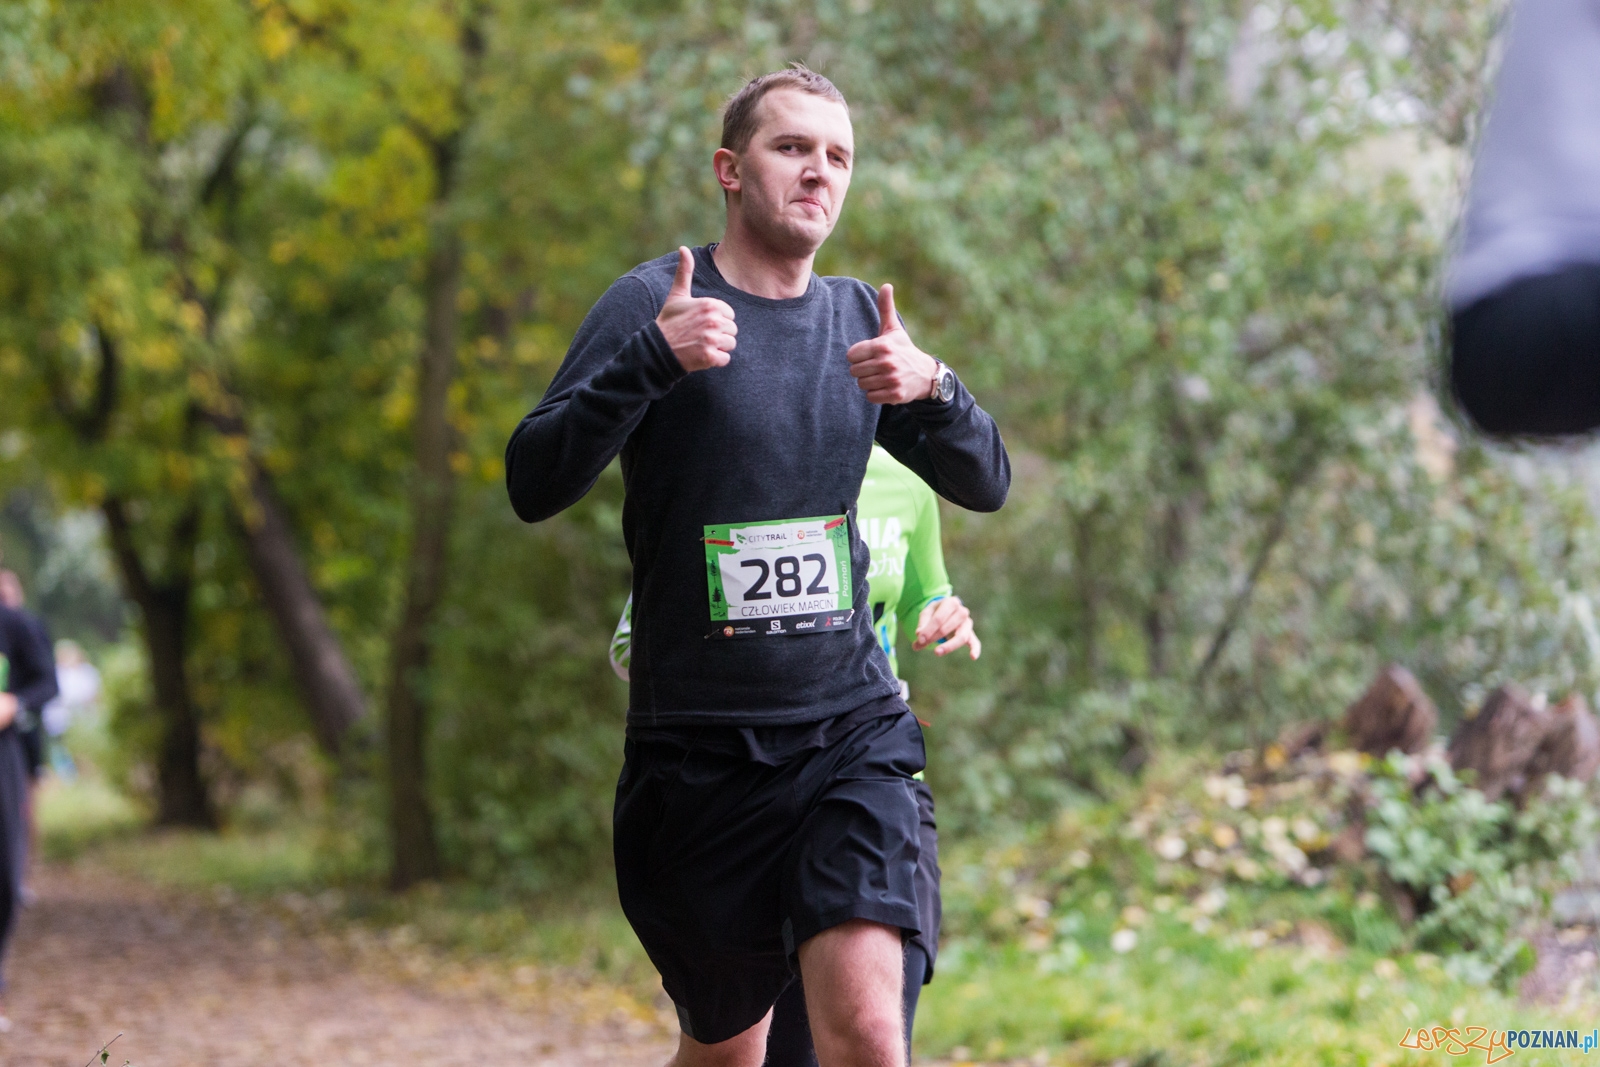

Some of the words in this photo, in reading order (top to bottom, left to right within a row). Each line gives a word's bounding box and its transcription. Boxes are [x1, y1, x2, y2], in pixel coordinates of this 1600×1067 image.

[740, 553, 829, 601] 282
[741, 602, 796, 617] CZŁOWIEK
[799, 599, 834, 612] MARCIN
